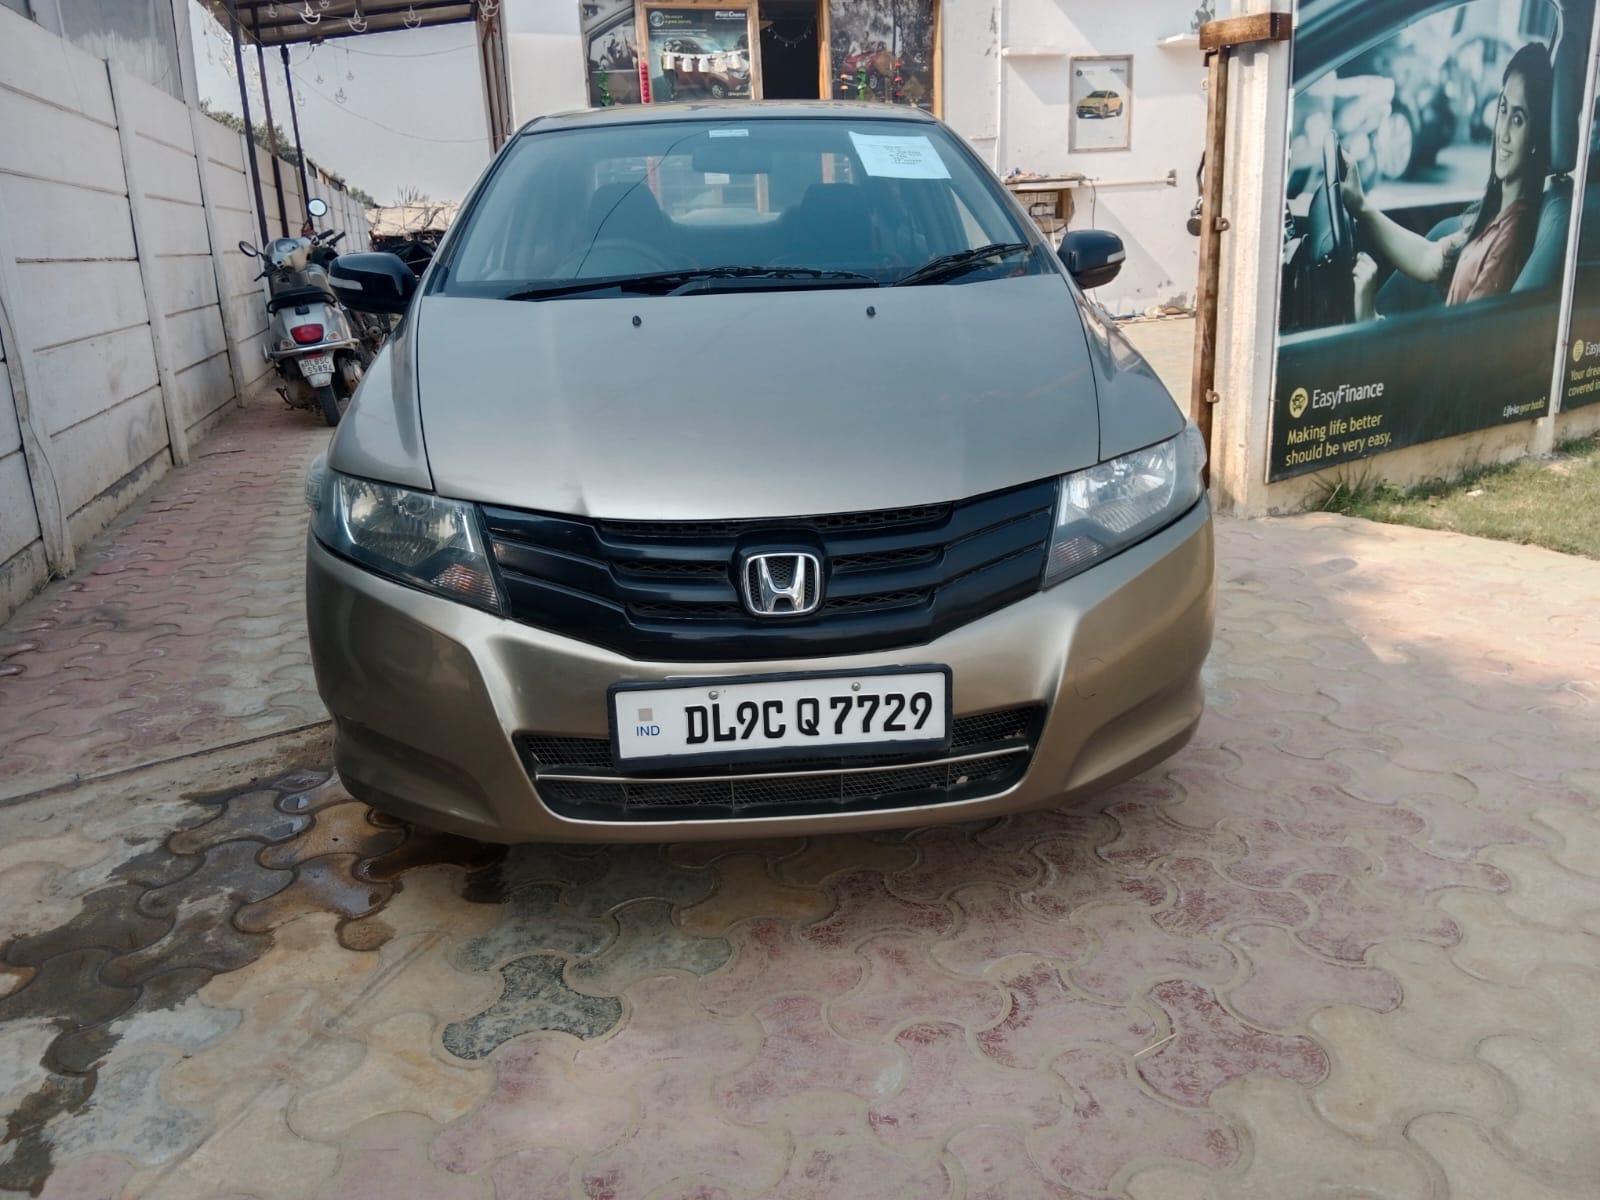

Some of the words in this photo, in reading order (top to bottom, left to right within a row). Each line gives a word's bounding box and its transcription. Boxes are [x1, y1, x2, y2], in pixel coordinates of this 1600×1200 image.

[1568, 379, 1595, 397] covered
[1571, 370, 1585, 381] Your
[1312, 382, 1384, 410] EasyFinance
[1287, 425, 1326, 446] Making
[1329, 418, 1347, 436] life
[1349, 414, 1383, 432] better
[1285, 443, 1323, 467] should
[1325, 441, 1340, 457] be
[1342, 437, 1366, 454] very
[1367, 431, 1392, 447] easy.
[636, 725, 661, 737] IND
[685, 700, 786, 744] DL9C
[797, 697, 820, 736] Q
[830, 691, 933, 735] 7729
